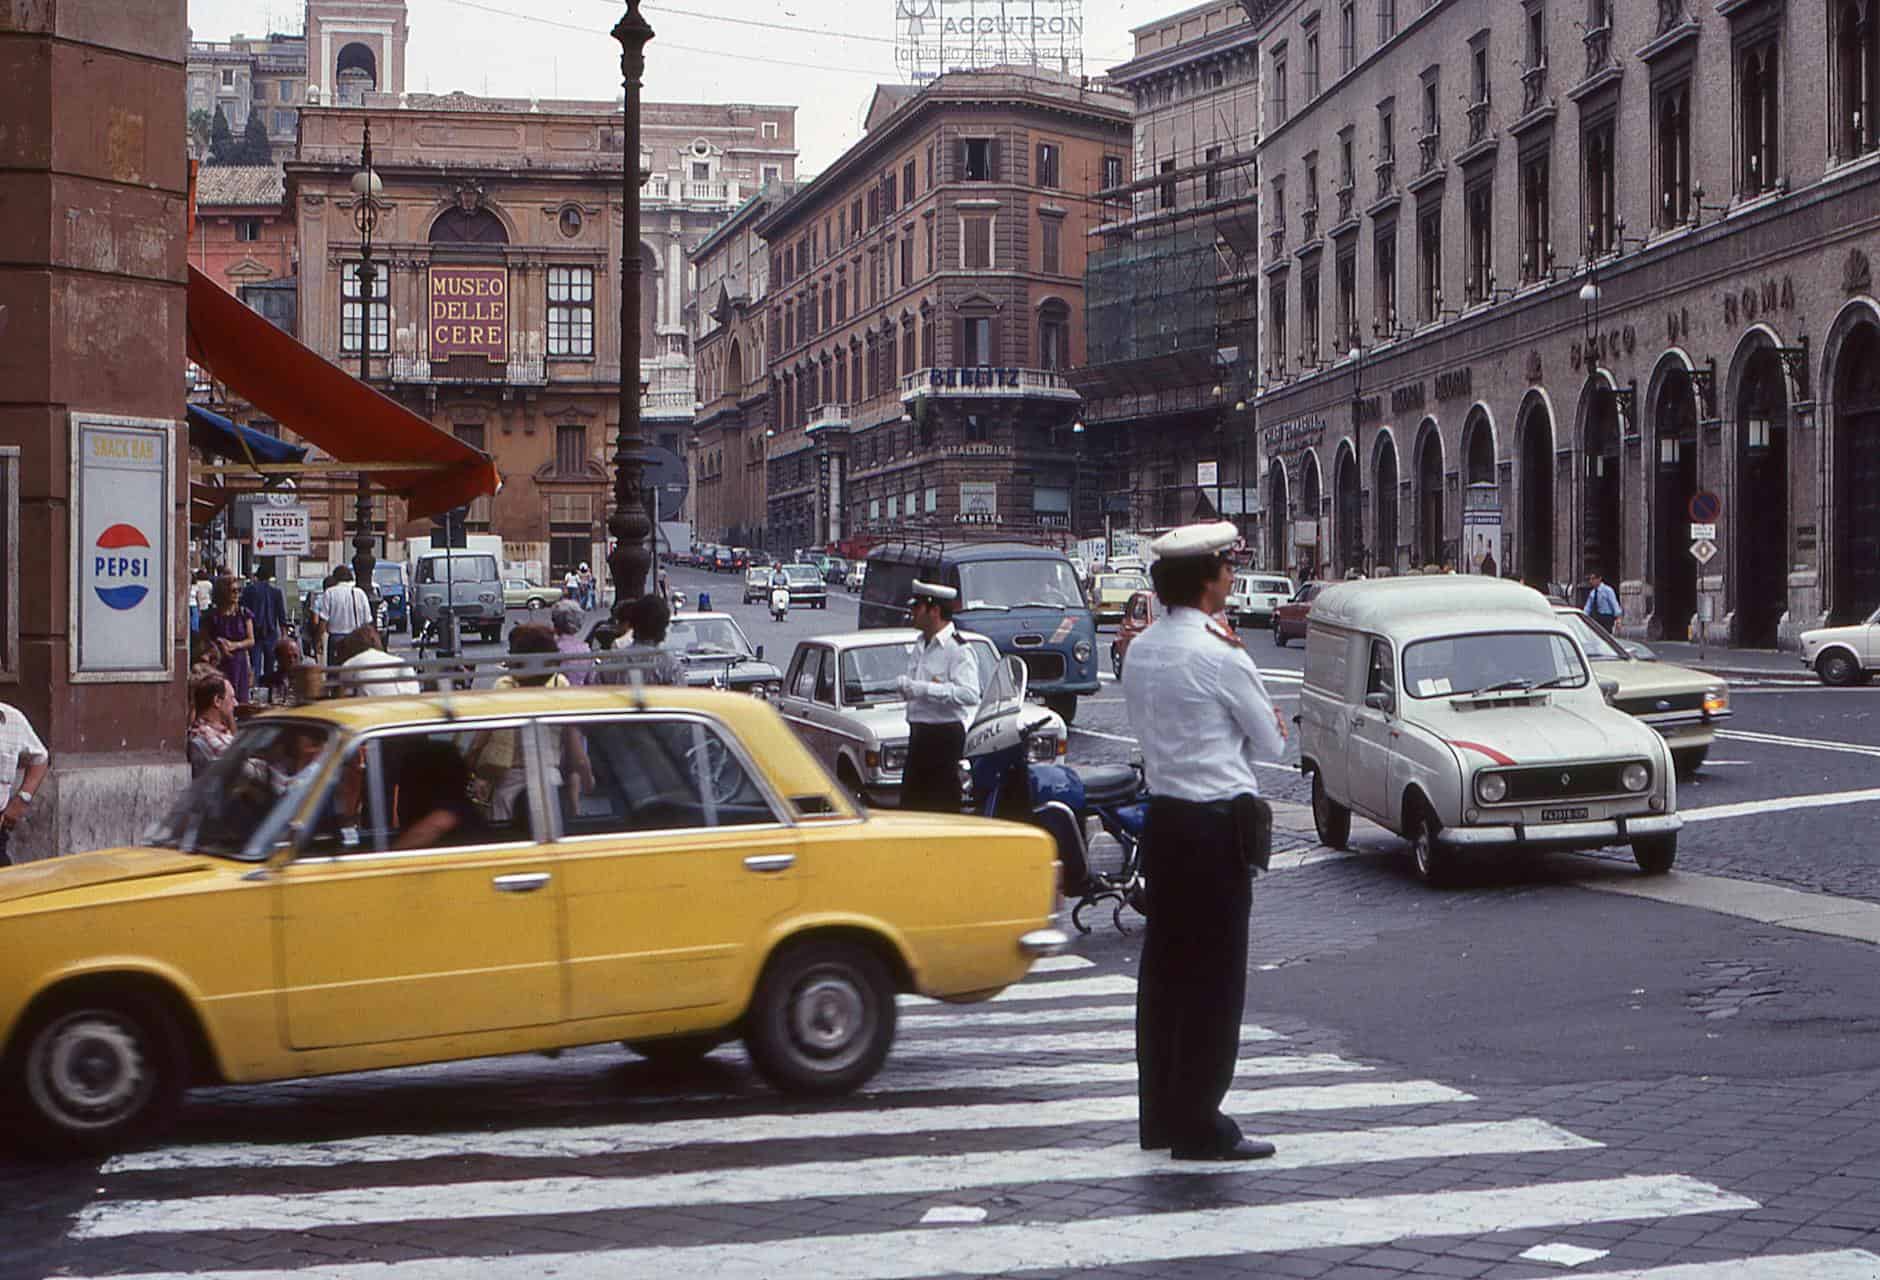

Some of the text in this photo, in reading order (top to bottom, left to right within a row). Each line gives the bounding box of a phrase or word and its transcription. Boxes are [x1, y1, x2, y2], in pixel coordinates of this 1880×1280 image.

[943, 16, 1084, 35] ACCUTRON
[433, 277, 503, 296] MUSEO
[433, 301, 503, 320] DELLE
[1724, 273, 1795, 329] ROMA
[435, 326, 501, 344] CERE
[93, 435, 154, 460] SNACK BAR
[259, 518, 304, 527] URBE
[95, 556, 148, 577] PEPSI
